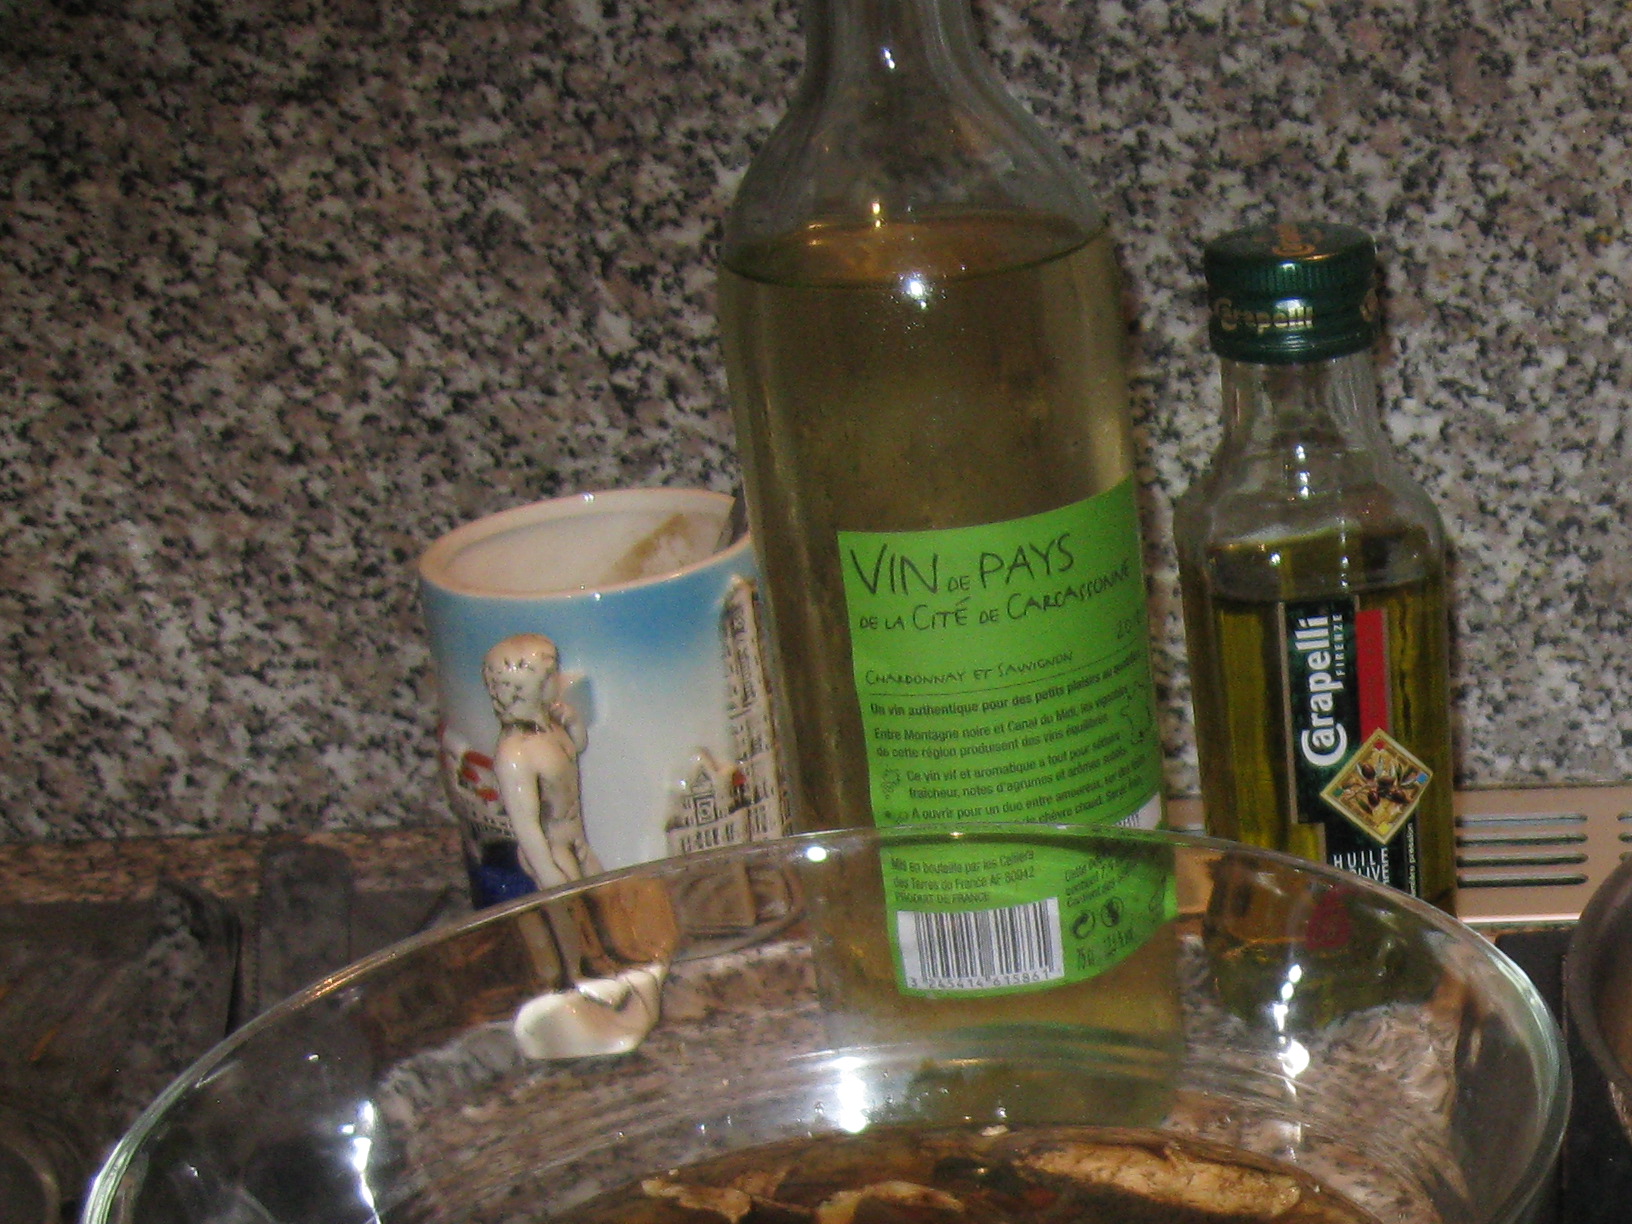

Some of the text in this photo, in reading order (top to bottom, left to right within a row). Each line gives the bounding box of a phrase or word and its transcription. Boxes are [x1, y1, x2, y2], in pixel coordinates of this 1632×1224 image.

[850, 533, 1074, 595] VIN DE PAYS
[859, 558, 1130, 631] DE LA CITÉ DE CARCASSONNE
[1332, 613, 1346, 677] FIRENZE
[865, 651, 1073, 685] CHARDONNAY ET SAUVIGNON
[870, 703, 886, 715] Un
[888, 703, 906, 716] vin
[908, 703, 979, 717] authentique
[982, 698, 1009, 713] pour
[1012, 695, 1032, 706] des
[1034, 686, 1065, 703] petits
[1294, 616, 1348, 767] Carapelli
[875, 728, 901, 740] Entre
[904, 728, 959, 742] Montagne
[962, 725, 991, 738] noire
[993, 723, 1005, 734] et
[1007, 716, 1039, 732] Canal
[892, 747, 919, 758] cette
[960, 738, 1019, 759] produisent
[1022, 735, 1041, 747] des
[907, 770, 921, 781] Ce
[923, 770, 941, 782] vin
[943, 769, 957, 781] vif
[960, 769, 971, 780] et
[974, 760, 1036, 777] aromatique
[962, 784, 993, 796] notes
[922, 806, 954, 819] ouvrir
[957, 805, 982, 819] pour
[985, 804, 1000, 815] un
[1002, 800, 1023, 813] duo
[1333, 847, 1389, 869] HUILE
[911, 976, 918, 987] 3
[993, 967, 1050, 986] 615861
